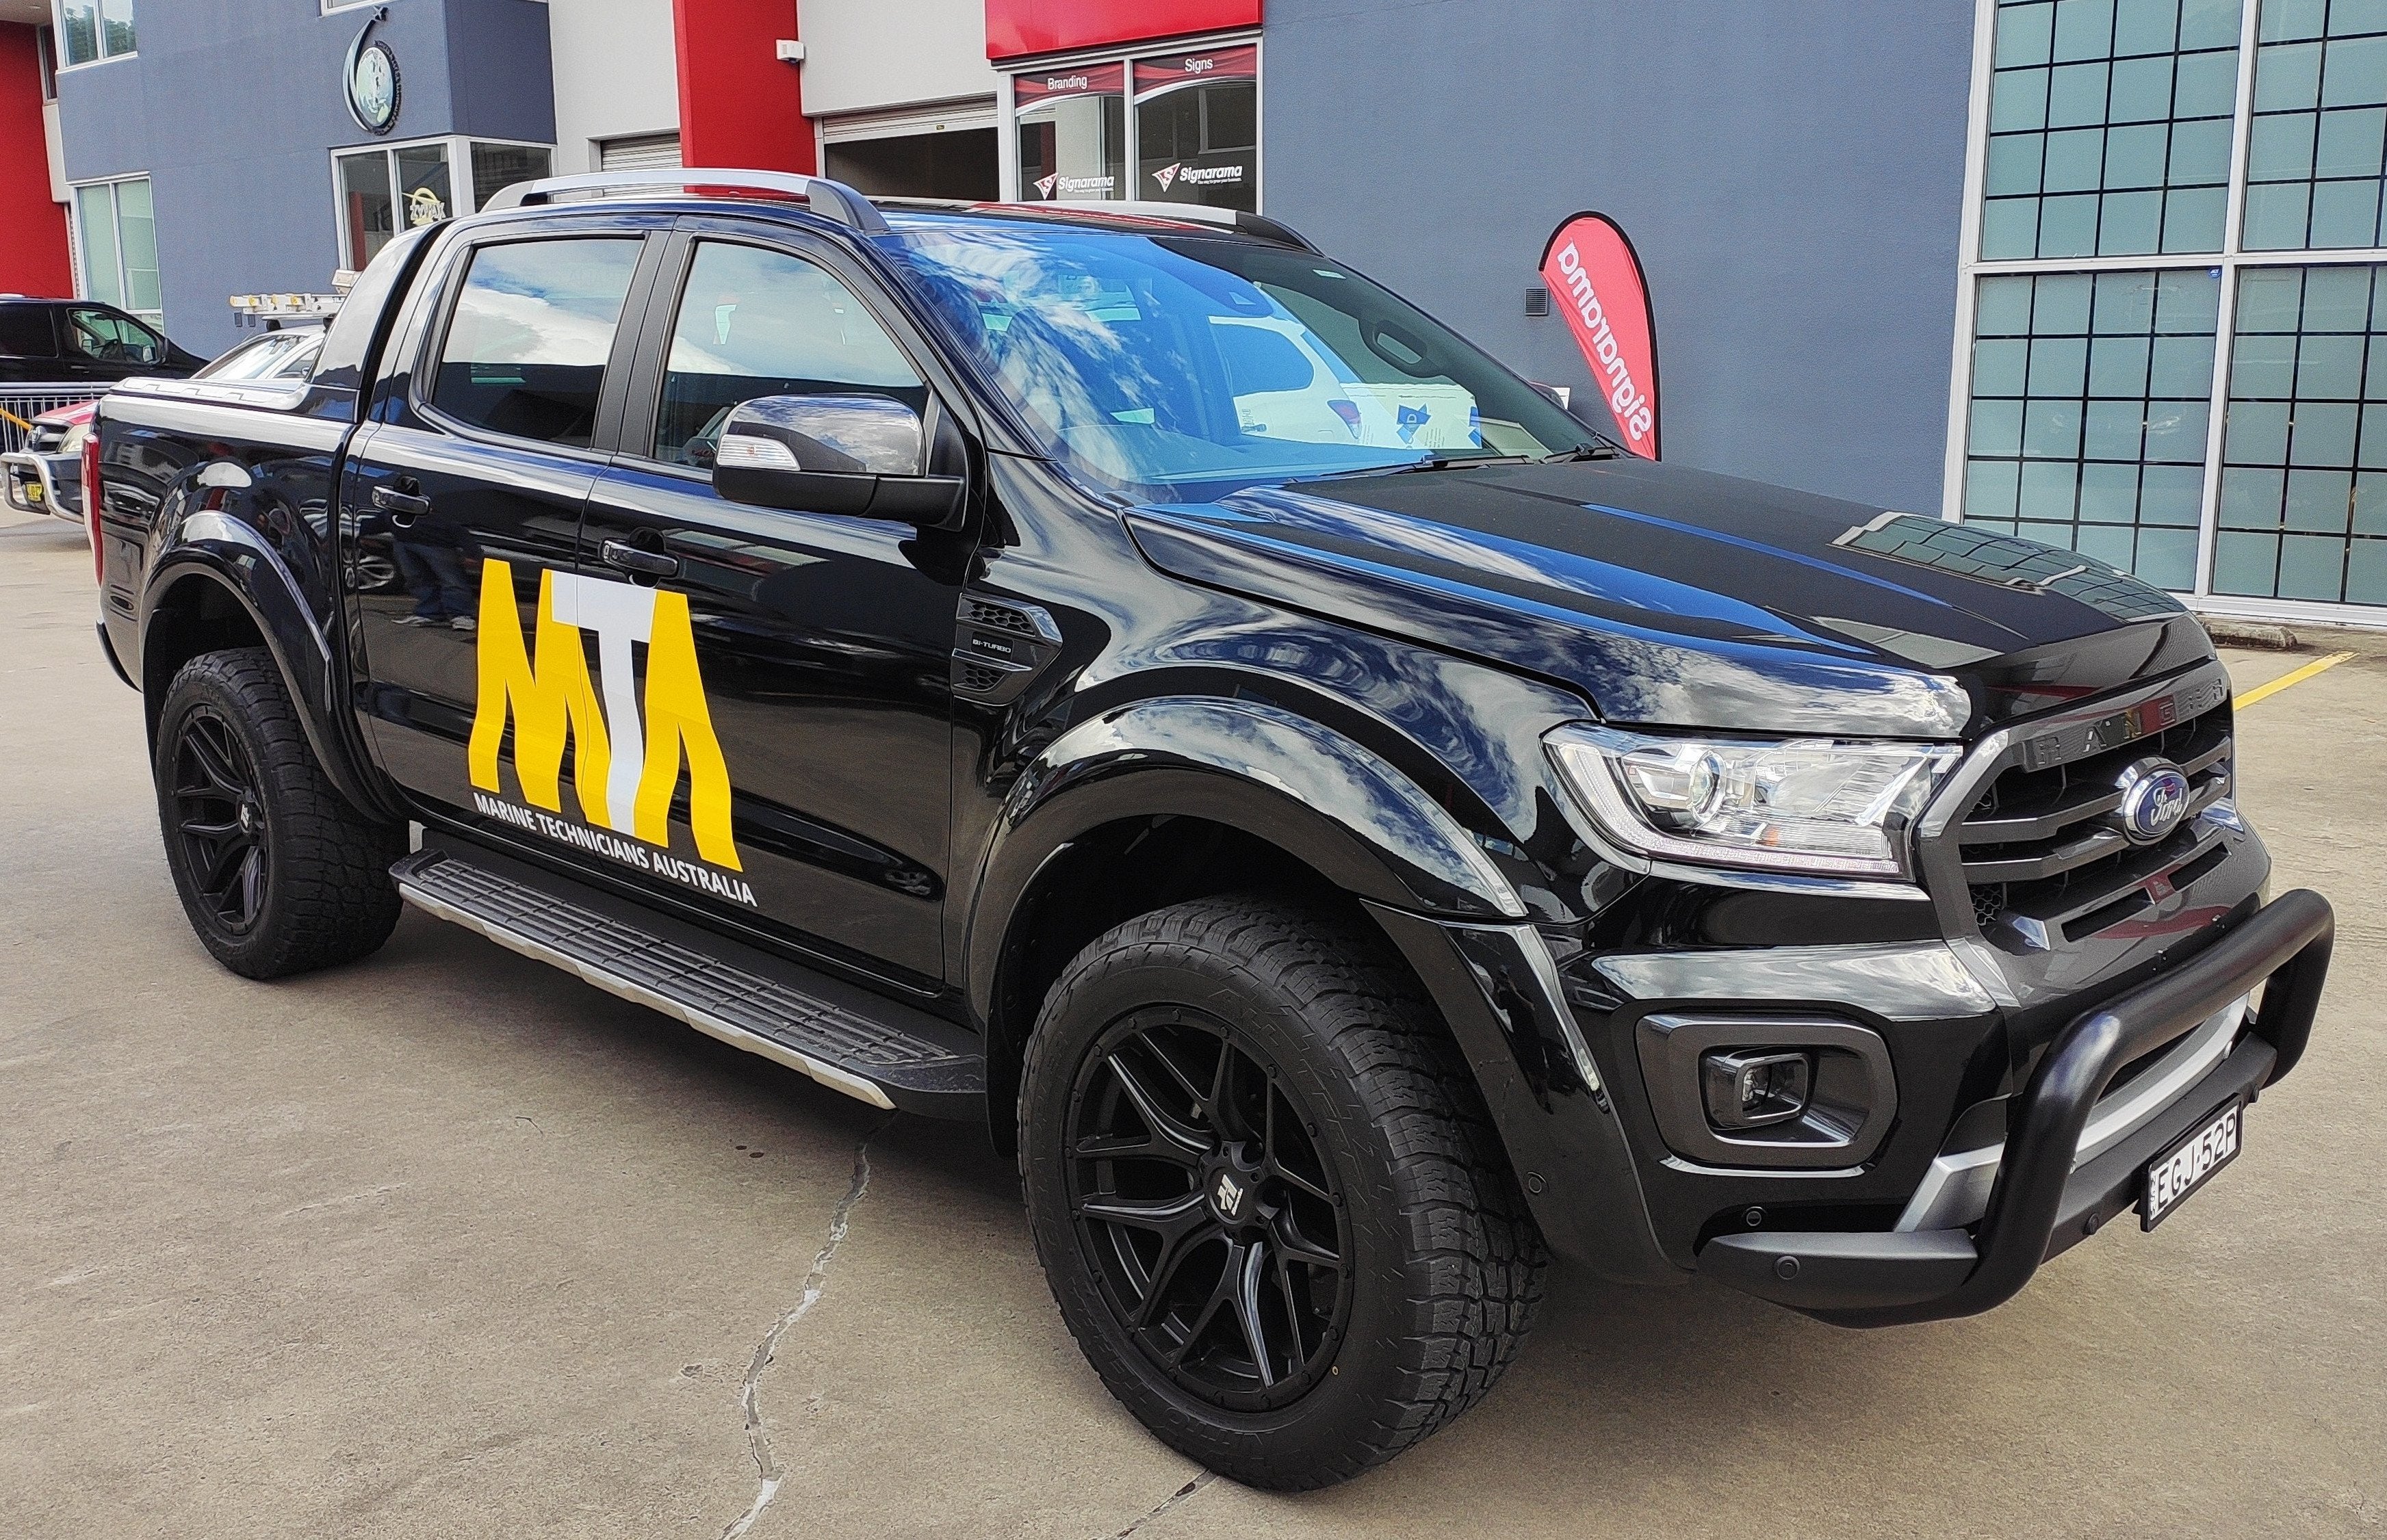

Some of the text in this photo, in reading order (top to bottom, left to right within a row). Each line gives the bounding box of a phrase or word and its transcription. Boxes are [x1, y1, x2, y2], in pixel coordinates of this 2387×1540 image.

[1184, 57, 1213, 74] Signs
[1047, 75, 1087, 90] Branding
[1179, 166, 1243, 184] Signarama
[1058, 176, 1115, 192] Signarama
[972, 639, 1011, 653] BI-TURBO
[468, 557, 743, 872] MTA
[2150, 787, 2183, 826] Ford
[473, 792, 758, 908] MARINE TECHNICIANS AUSTRALIA
